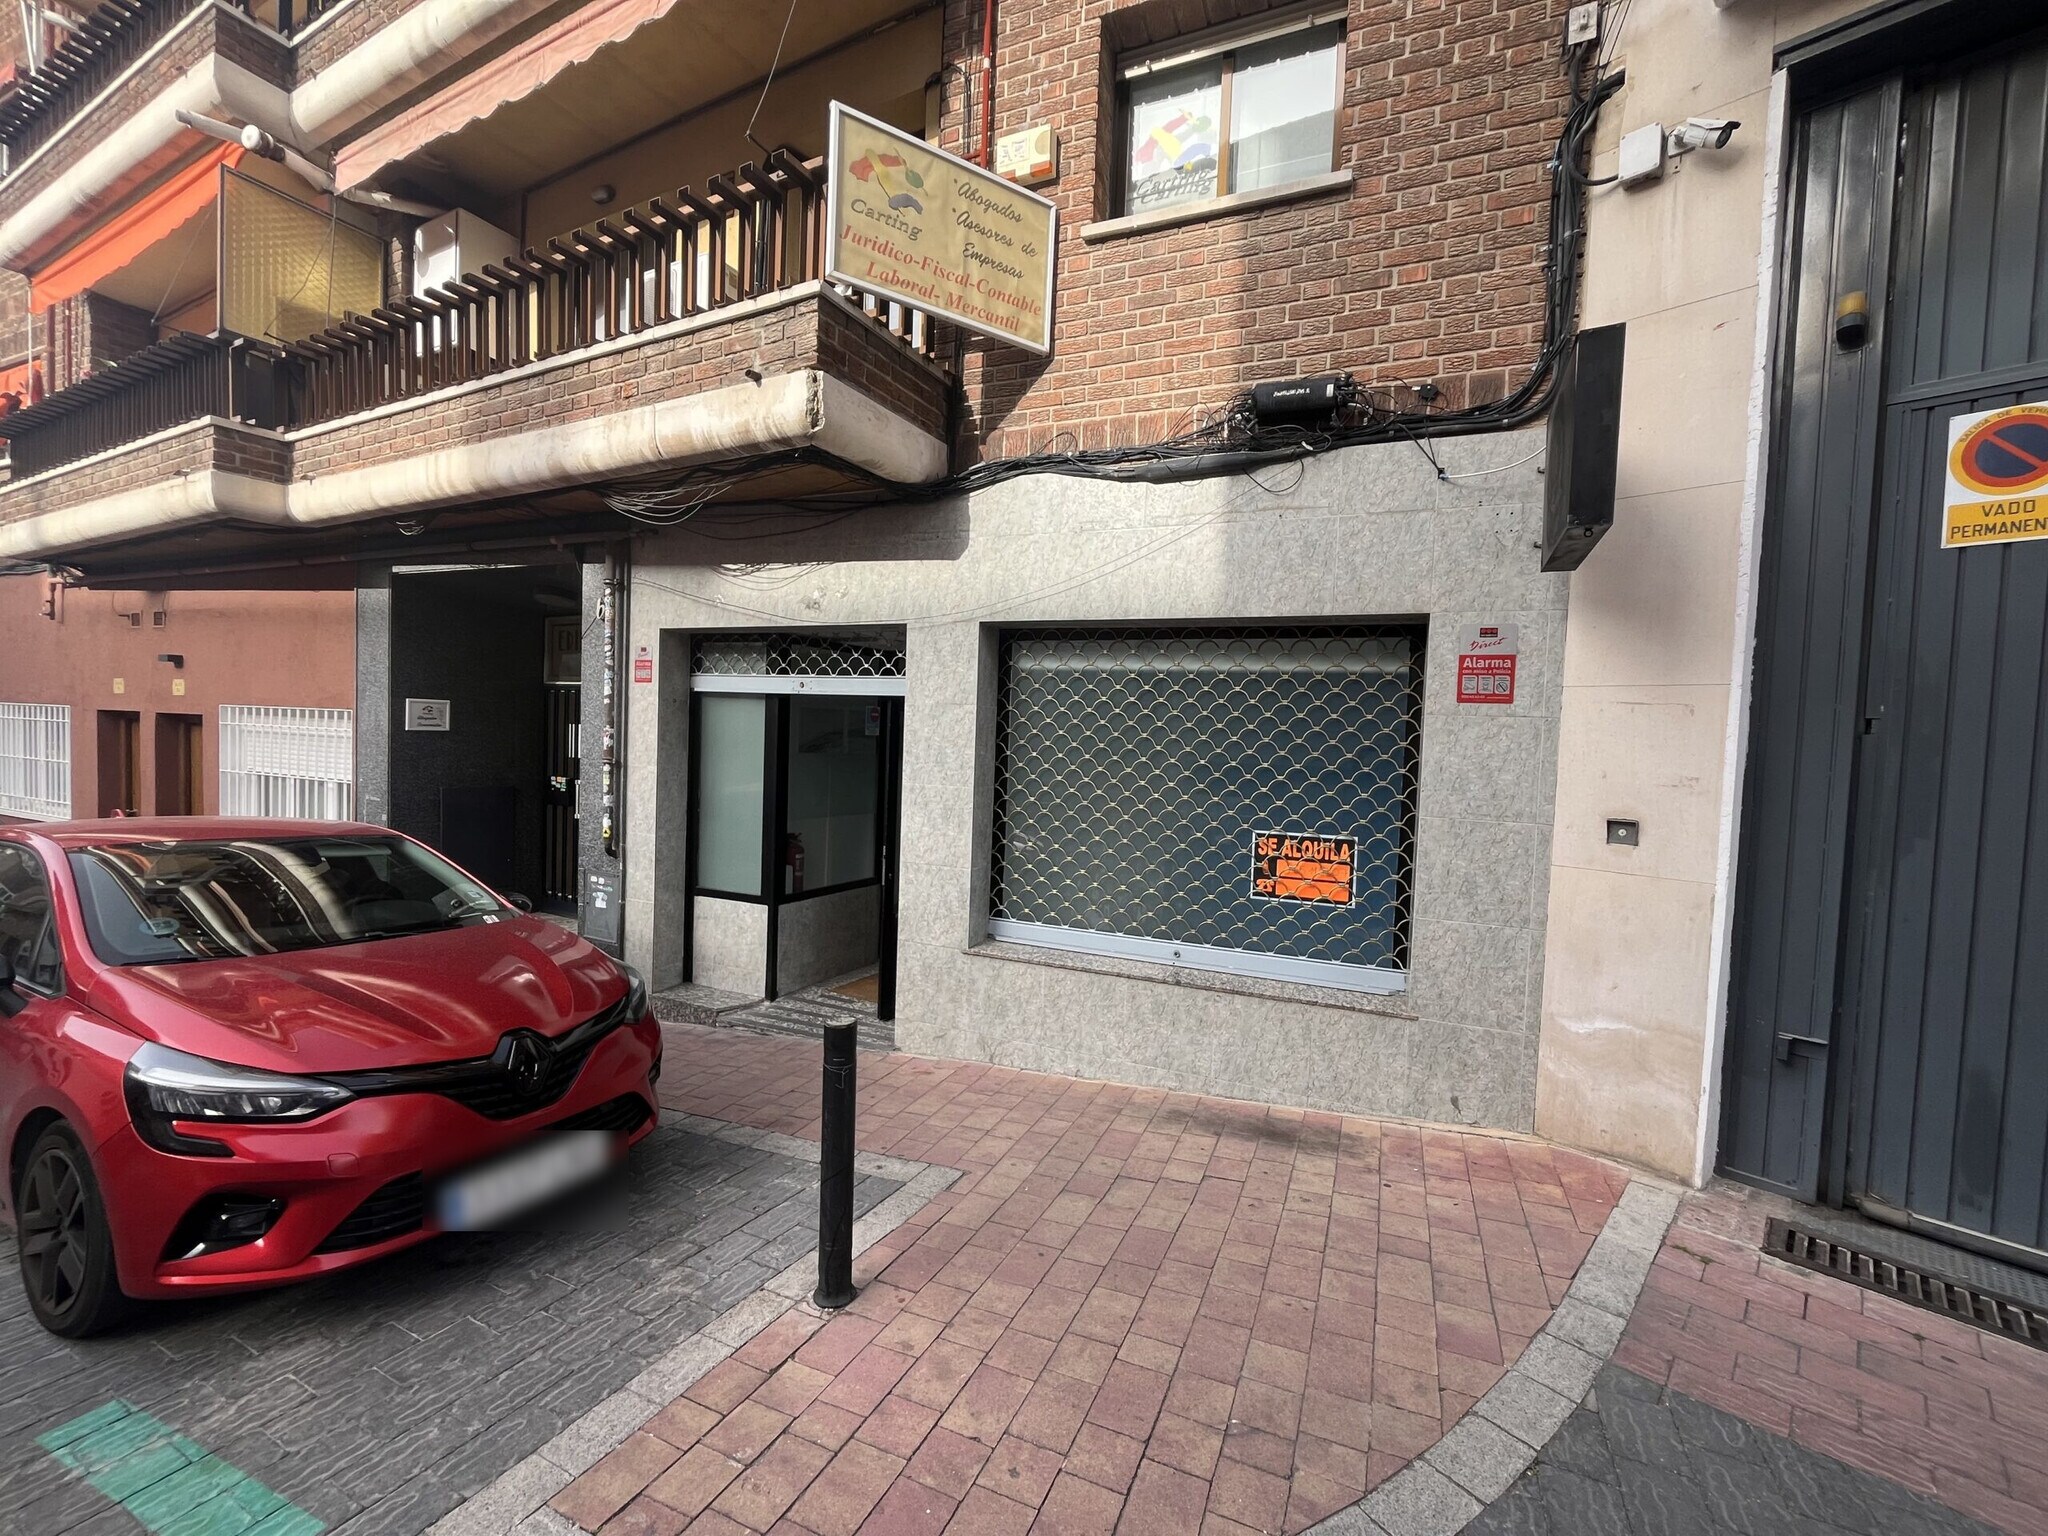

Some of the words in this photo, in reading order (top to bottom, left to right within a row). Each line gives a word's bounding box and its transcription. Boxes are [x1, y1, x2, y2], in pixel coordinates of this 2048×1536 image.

[851, 199, 922, 241] Carting
[958, 182, 1022, 223] Abogados
[957, 211, 1014, 247] Asesores
[1021, 242, 1037, 257] de
[963, 242, 1024, 279] Empresas
[945, 291, 1020, 332] Mercantil
[1997, 409, 2012, 418] DE
[1982, 500, 2036, 517] VADO
[1463, 657, 1511, 668] Alarma
[1258, 837, 1278, 856] SE
[1282, 839, 1351, 862] ALQUILA
